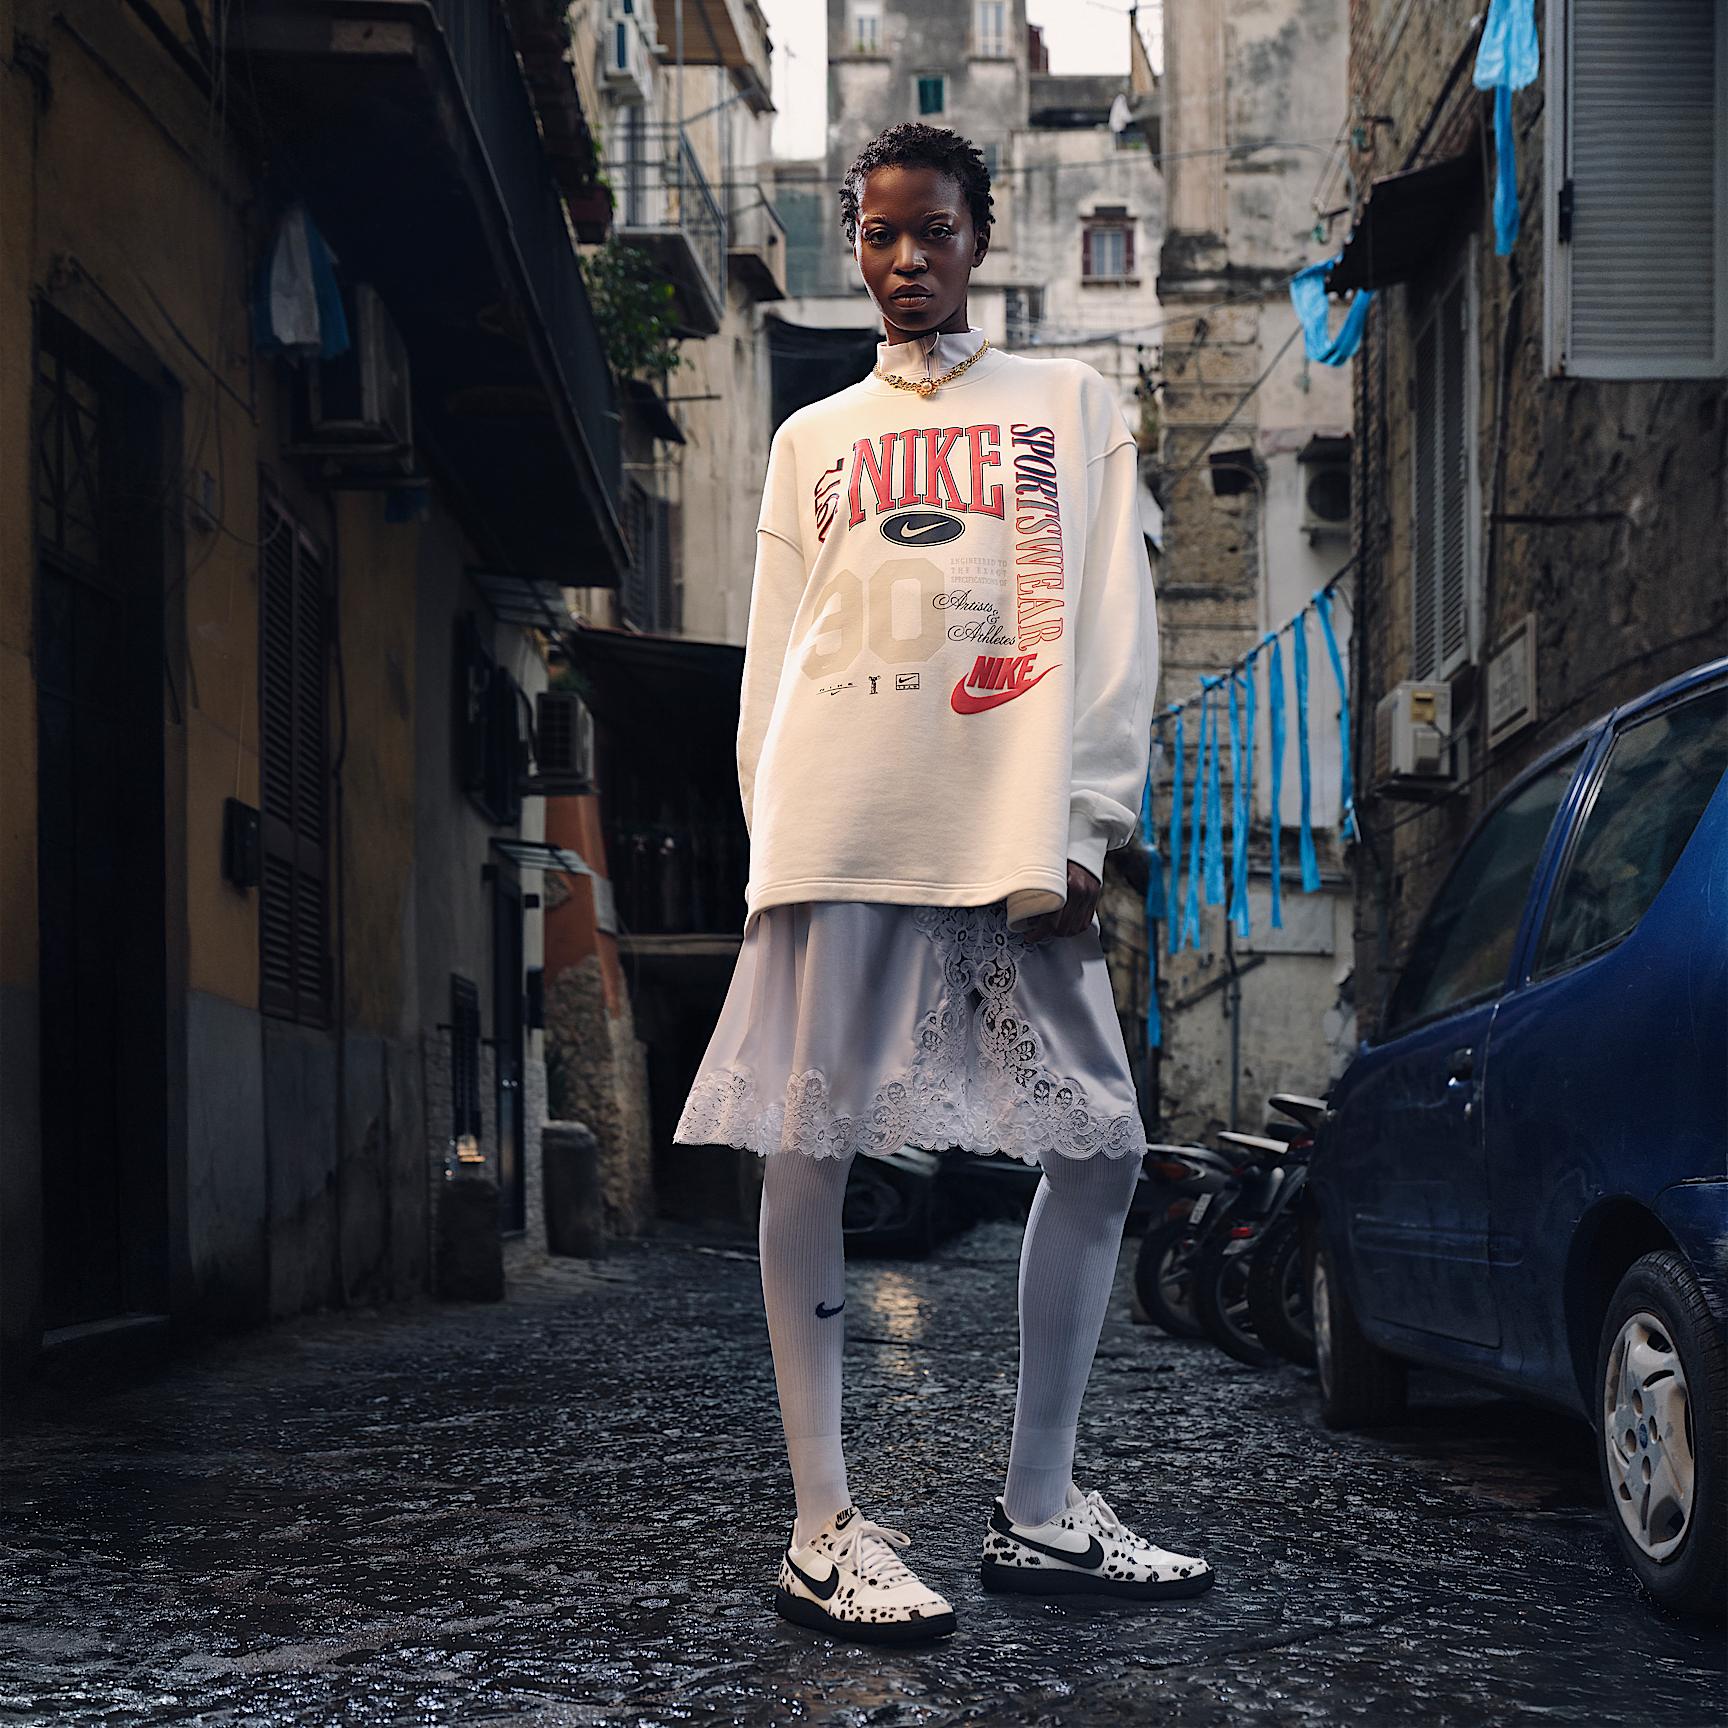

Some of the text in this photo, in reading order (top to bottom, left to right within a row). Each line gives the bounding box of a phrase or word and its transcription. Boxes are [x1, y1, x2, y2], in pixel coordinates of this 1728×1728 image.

[848, 424, 1004, 531] NIKE
[1011, 423, 1064, 651] SPORTSWEAR
[933, 590, 993, 612] Artists
[986, 609, 1000, 624] &
[947, 621, 1016, 646] Athletes
[966, 653, 1038, 690] NIKE
[836, 1507, 856, 1523] NIKE
